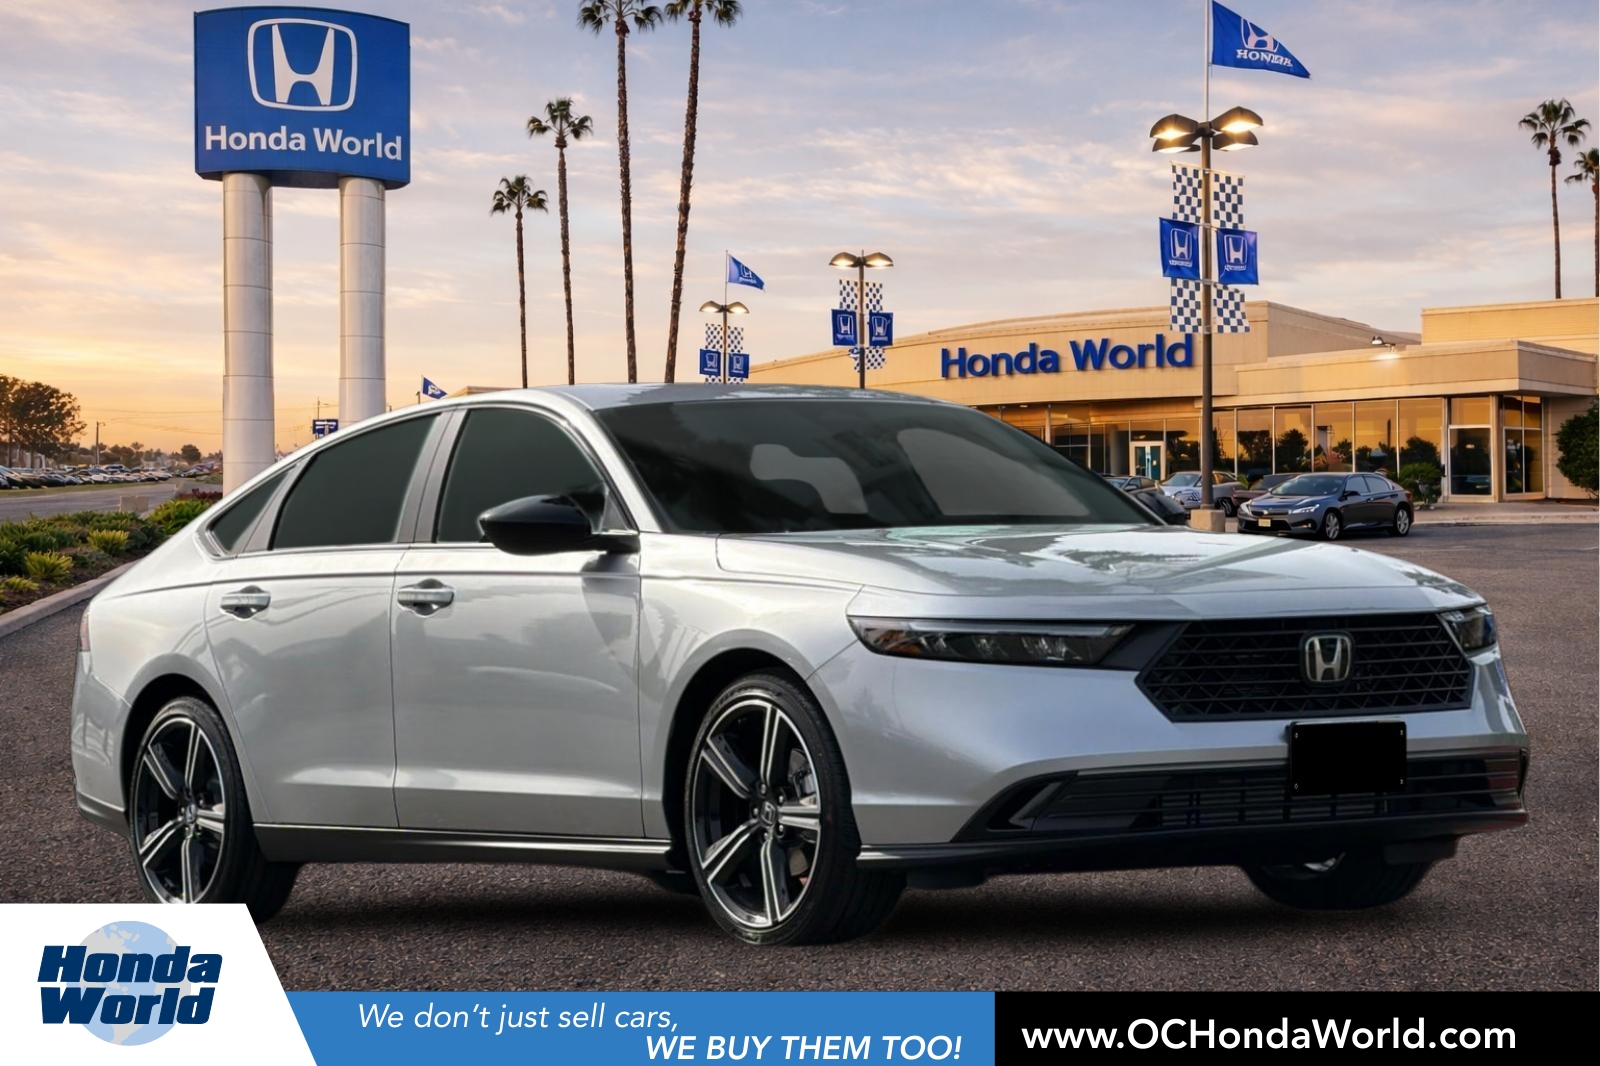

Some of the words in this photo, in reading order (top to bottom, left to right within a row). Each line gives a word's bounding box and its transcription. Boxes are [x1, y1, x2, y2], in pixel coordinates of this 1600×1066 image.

[205, 125, 306, 151] Honda
[313, 127, 402, 161] World
[941, 342, 1060, 378] Honda
[1069, 333, 1194, 371] World
